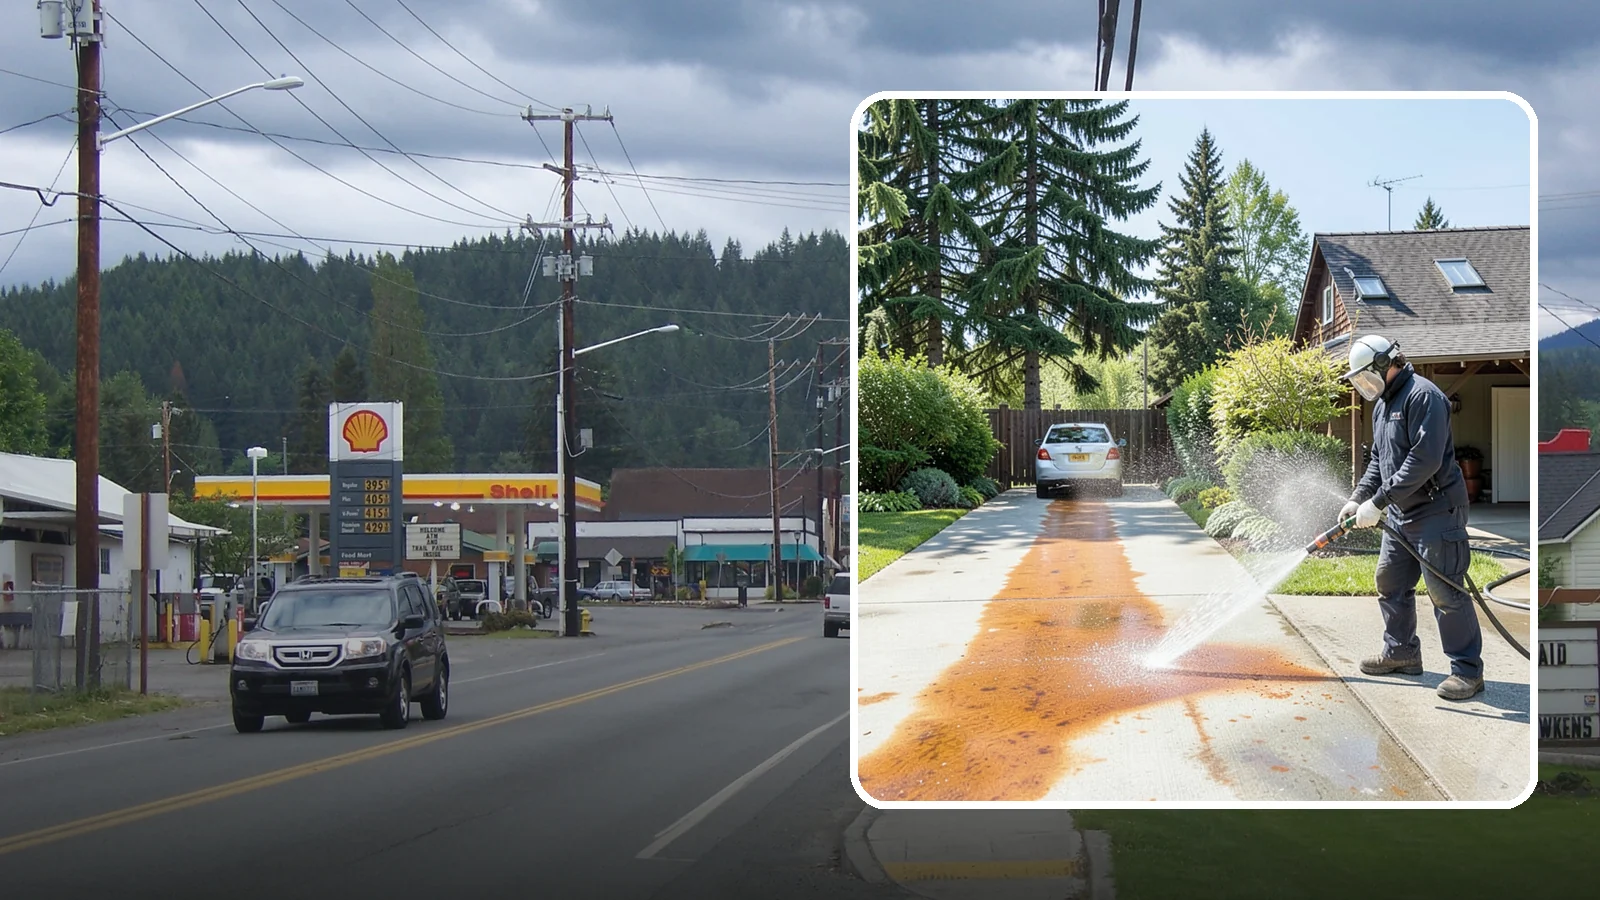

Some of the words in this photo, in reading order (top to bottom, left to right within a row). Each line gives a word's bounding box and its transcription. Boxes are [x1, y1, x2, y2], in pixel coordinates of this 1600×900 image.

[366, 480, 383, 490] 395
[490, 484, 547, 499] Shell
[366, 494, 383, 504] 405
[366, 508, 383, 518] 415
[366, 522, 383, 532] 429
[1539, 643, 1567, 665] AID
